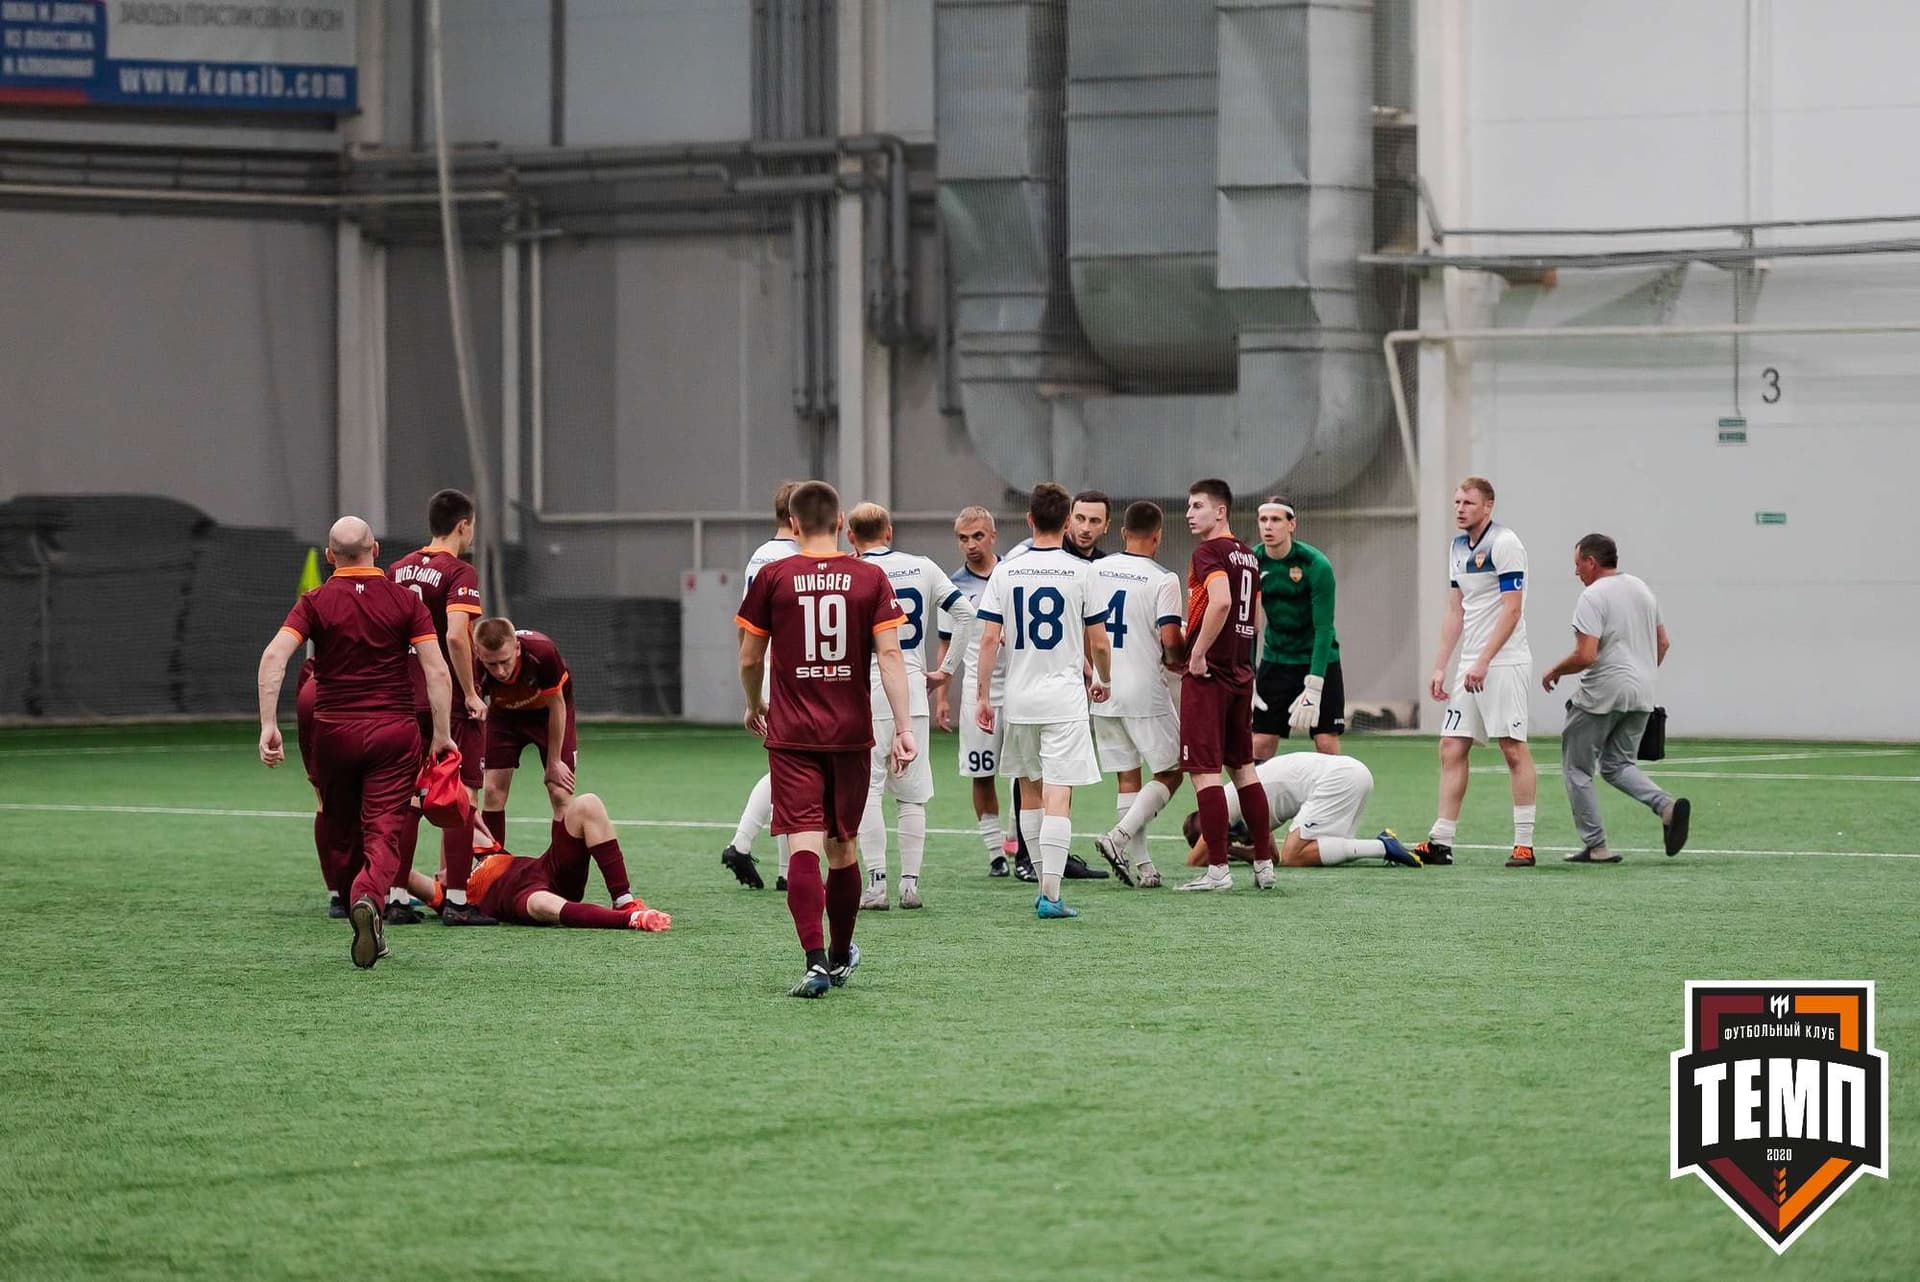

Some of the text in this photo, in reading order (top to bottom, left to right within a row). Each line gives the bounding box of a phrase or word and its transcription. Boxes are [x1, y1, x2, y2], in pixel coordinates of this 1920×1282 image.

[1762, 367, 1781, 404] 3
[793, 573, 852, 593] ШИБАЕВ
[1239, 568, 1253, 622] 9
[798, 594, 847, 662] 19
[1012, 586, 1065, 651] 18
[1104, 589, 1128, 649] 4
[796, 664, 852, 679] SEUS
[1445, 709, 1462, 731] 77
[968, 750, 994, 772] 96
[1183, 744, 1189, 761] 9
